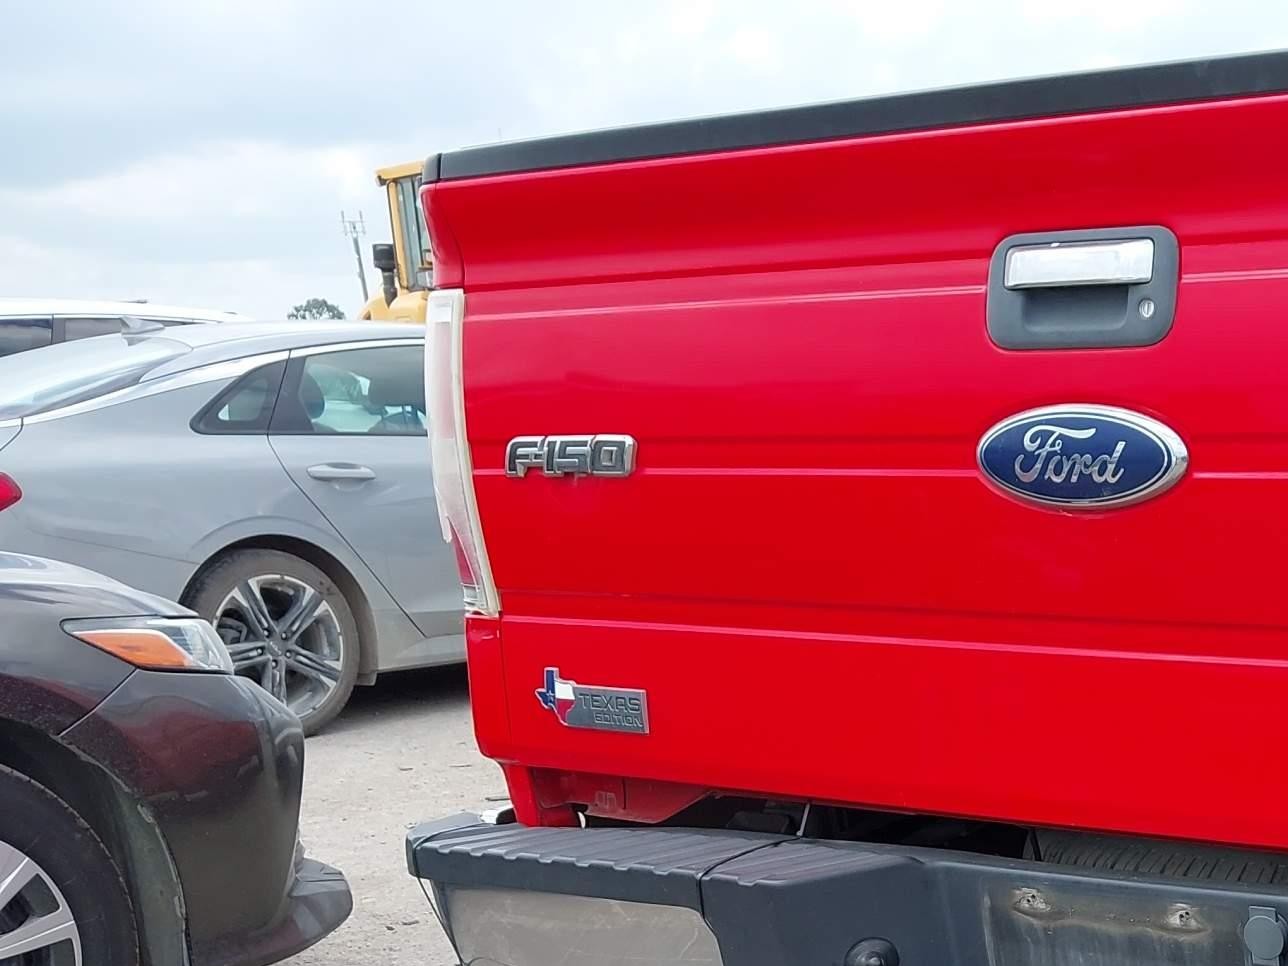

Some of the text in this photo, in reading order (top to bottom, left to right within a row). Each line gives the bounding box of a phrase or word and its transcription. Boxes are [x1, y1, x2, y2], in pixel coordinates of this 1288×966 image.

[506, 434, 638, 477] F-150
[1015, 425, 1126, 484] Ford
[578, 693, 641, 714] TEXAS
[594, 712, 644, 728] EDITION
